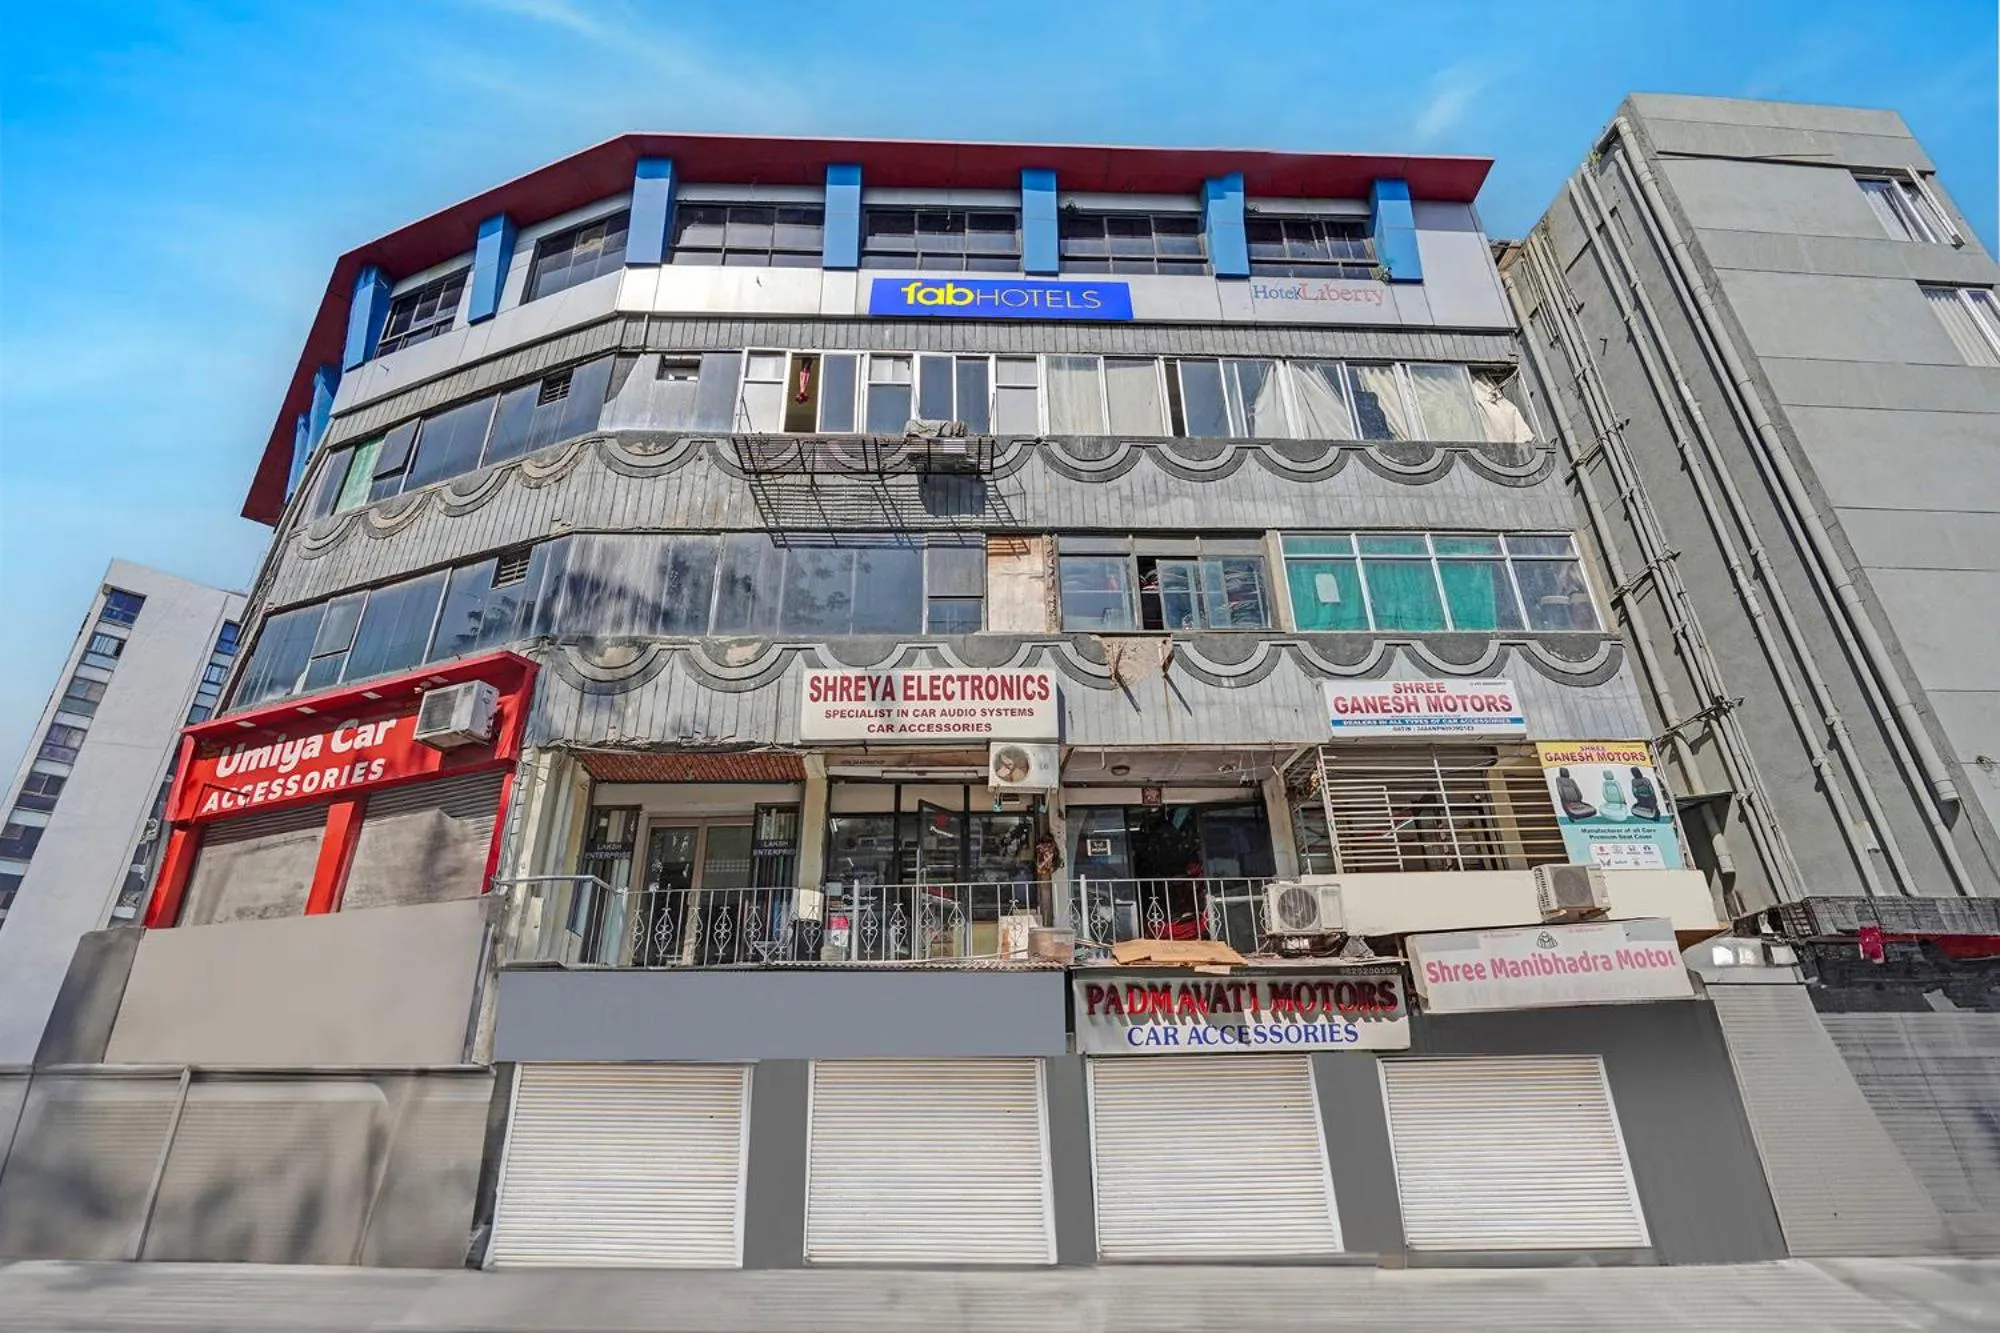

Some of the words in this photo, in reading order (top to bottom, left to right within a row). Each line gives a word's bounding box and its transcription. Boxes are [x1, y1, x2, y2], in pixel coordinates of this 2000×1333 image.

[809, 674, 897, 702] SHREYA
[903, 674, 1050, 702] ELECTRONICS
[1393, 682, 1447, 694] SHREE
[824, 708, 894, 719] SPECIALIST
[897, 708, 908, 718] IN
[912, 708, 936, 718] CAR
[940, 708, 977, 718] AUDIO
[980, 707, 1034, 718] SYSTEMS
[1334, 695, 1421, 714] GANESH
[1427, 694, 1513, 713] MOTORS
[867, 723, 895, 734] CAR
[898, 723, 993, 733] ACCESSORIES
[216, 733, 325, 778] Umiya
[331, 718, 397, 753] Car
[1545, 752, 1594, 762] GANESH
[1598, 752, 1646, 762] MOTORS
[202, 758, 386, 813] ACCESSORIES
[1426, 959, 1488, 984] Shree
[1490, 951, 1613, 980] Manibhadra
[1085, 982, 1259, 1016] PADMAVATI
[1269, 982, 1399, 1013] MOTORS
[1127, 1024, 1179, 1047] CAR
[1187, 1023, 1359, 1046] ACCESSORIES
